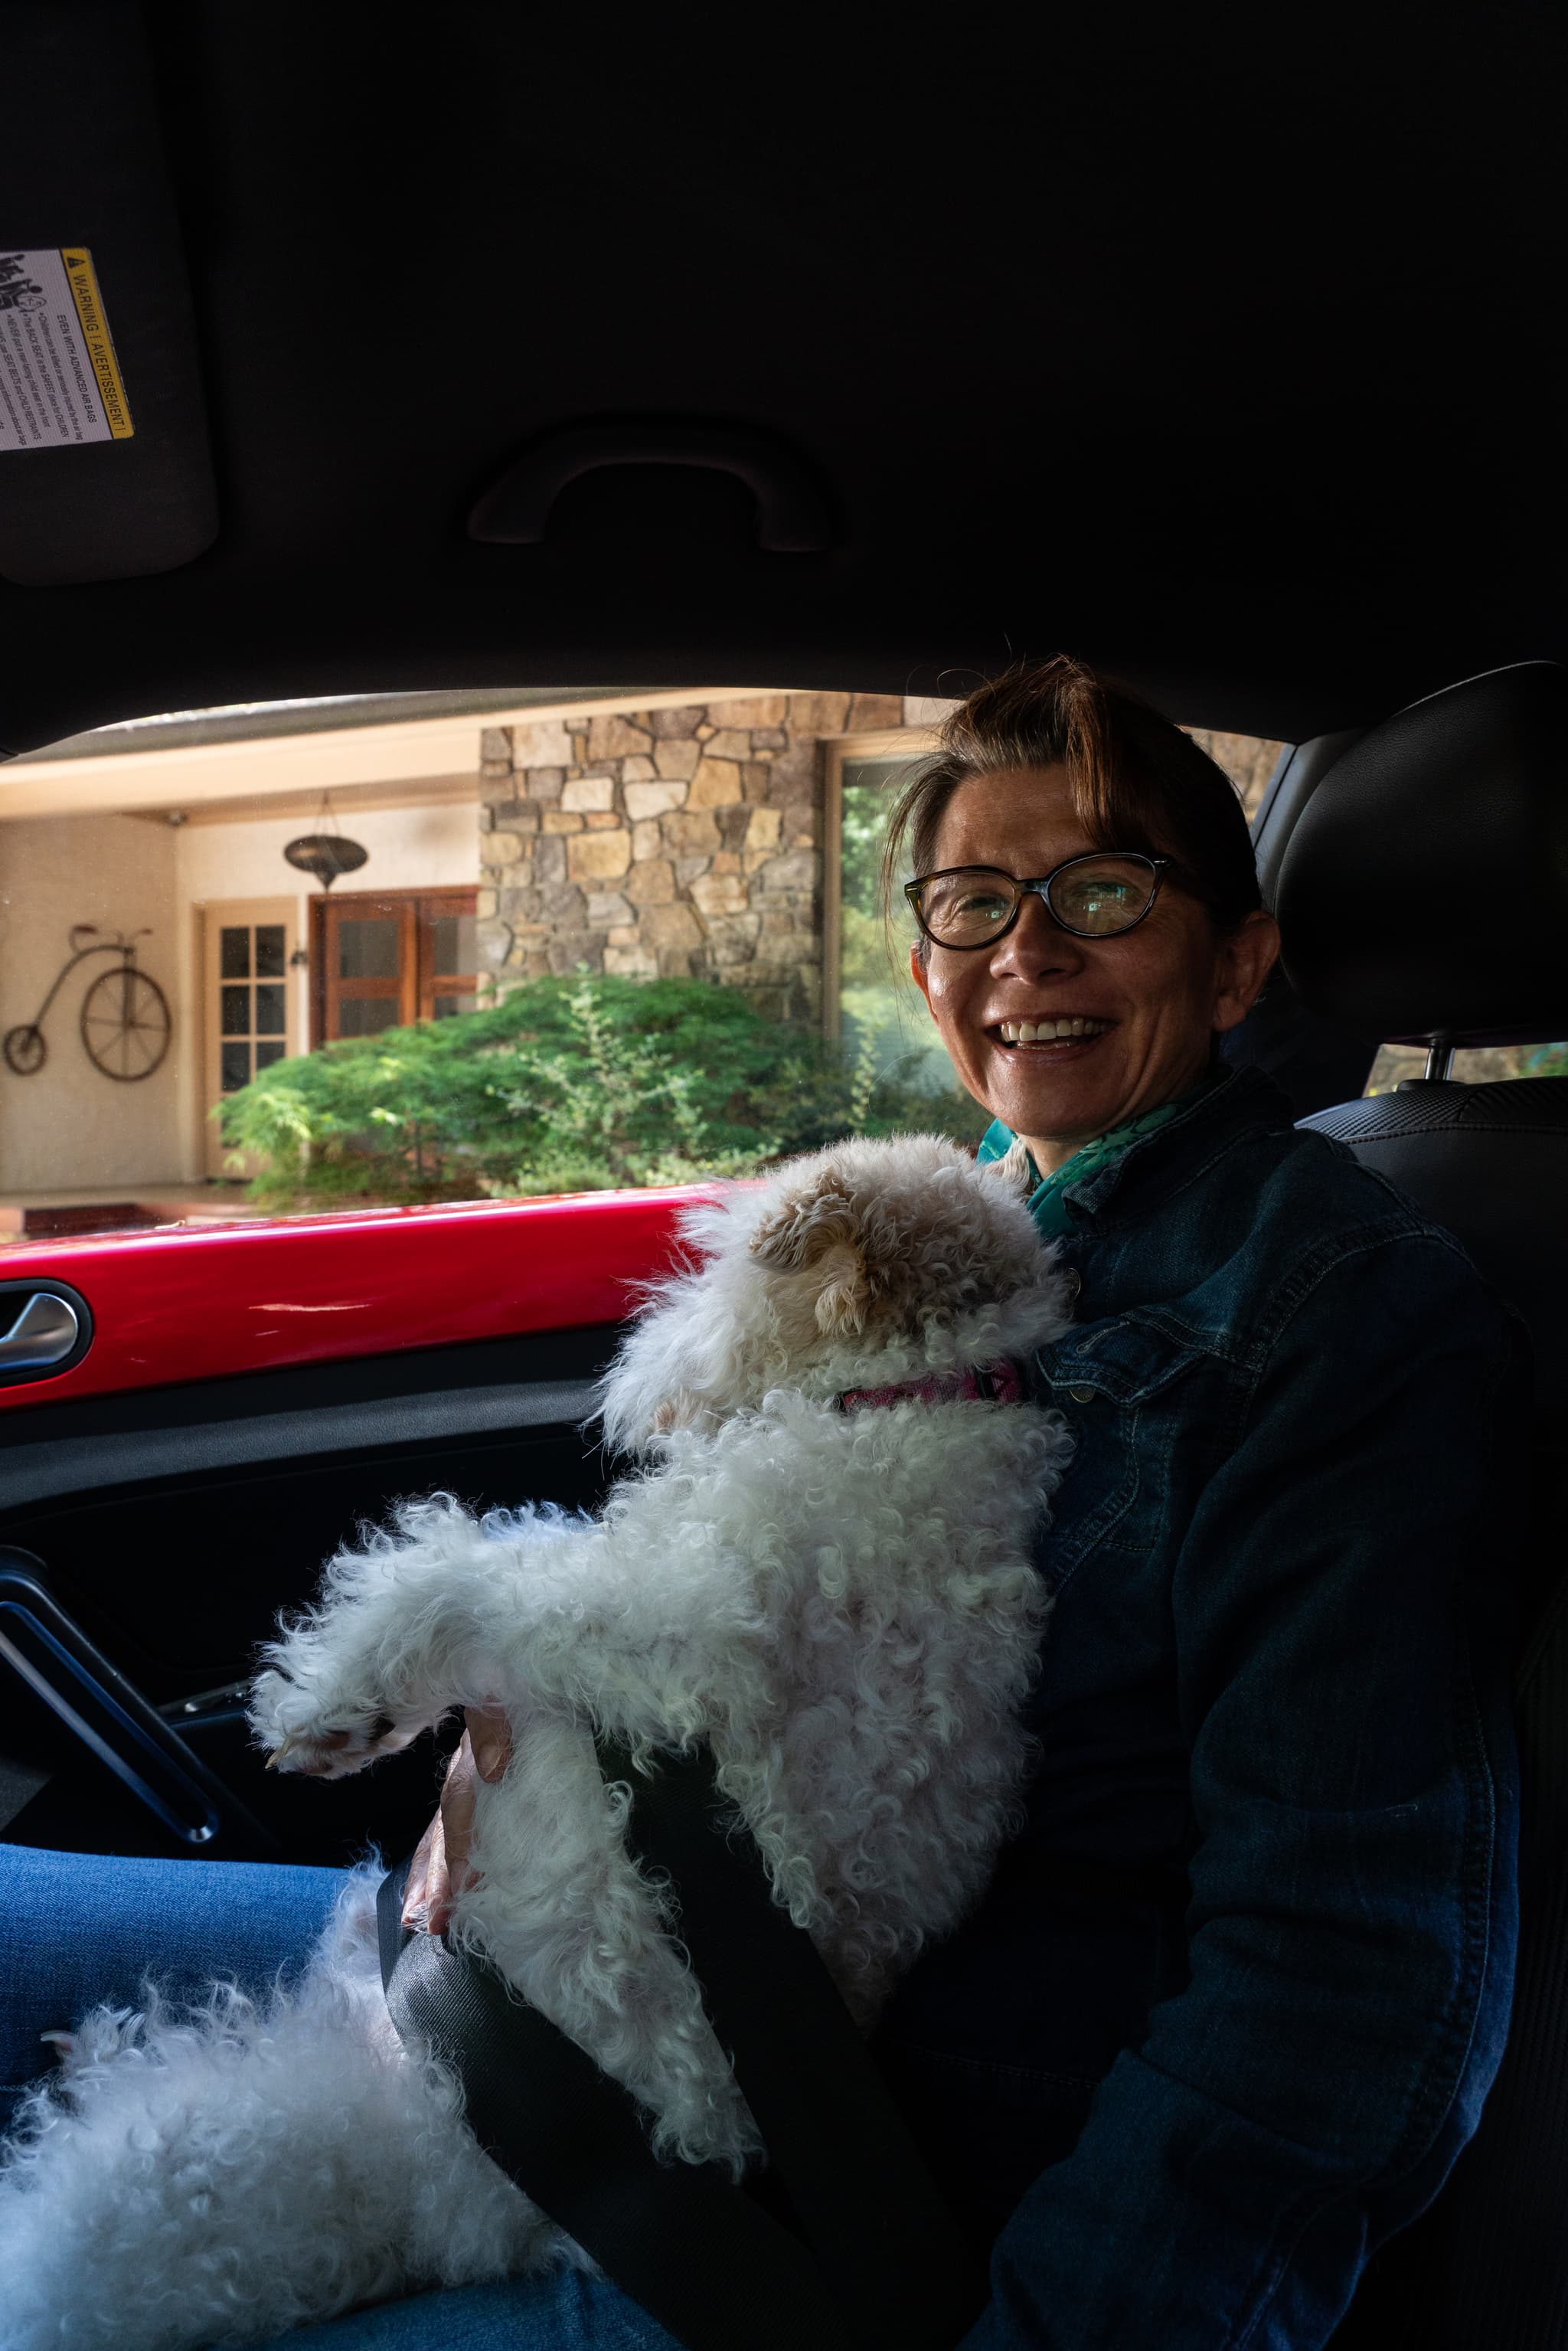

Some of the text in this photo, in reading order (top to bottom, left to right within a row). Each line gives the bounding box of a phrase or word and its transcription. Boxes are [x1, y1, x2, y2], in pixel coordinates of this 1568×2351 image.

[7, 318, 20, 337] NEVER
[23, 318, 32, 328] The
[12, 338, 22, 348] put
[27, 329, 38, 344] BACK
[32, 345, 42, 358] SEAT
[74, 274, 99, 332] WARNING
[92, 342, 125, 426] AVERTISSEMENT
[4, 354, 15, 368] SEAT
[19, 352, 33, 379] rear-facing
[9, 368, 20, 384] BELTS
[57, 315, 96, 423] EVEN WITH ADVANCED AIR BAGS
[29, 380, 38, 391] child
[39, 316, 51, 337] Children
[51, 355, 61, 368] killed
[57, 375, 69, 396] seriously
[64, 396, 74, 412] injured
[75, 432, 83, 440] bag
[41, 374, 54, 393] SAFEST
[1, 391, 16, 416] information
[19, 395, 30, 410] CHILD
[33, 392, 41, 402] seat
[47, 394, 57, 407] place
[24, 410, 41, 440] RESTRAINTS
[42, 416, 51, 427] front
[55, 414, 68, 437] CHILDREN
